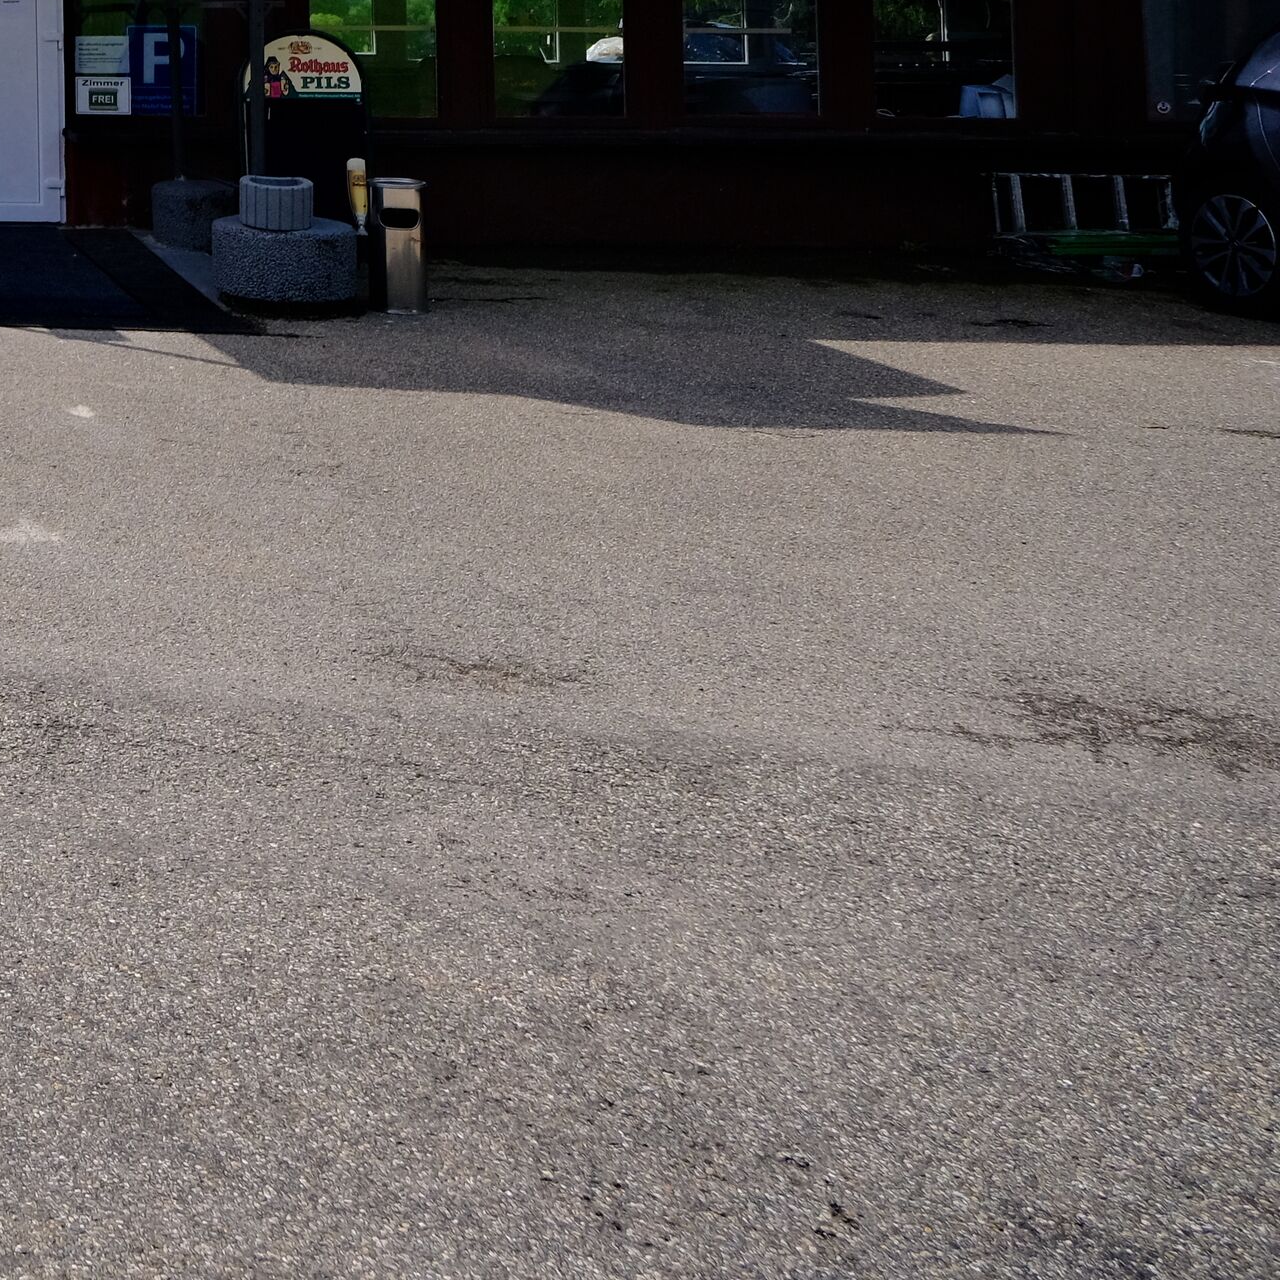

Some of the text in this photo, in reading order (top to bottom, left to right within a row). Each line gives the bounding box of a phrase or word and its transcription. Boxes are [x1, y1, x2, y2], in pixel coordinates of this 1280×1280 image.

[288, 56, 349, 75] Rothaus
[81, 79, 125, 87] Zimmer
[301, 76, 351, 89] PILS
[92, 94, 114, 104] FREI
